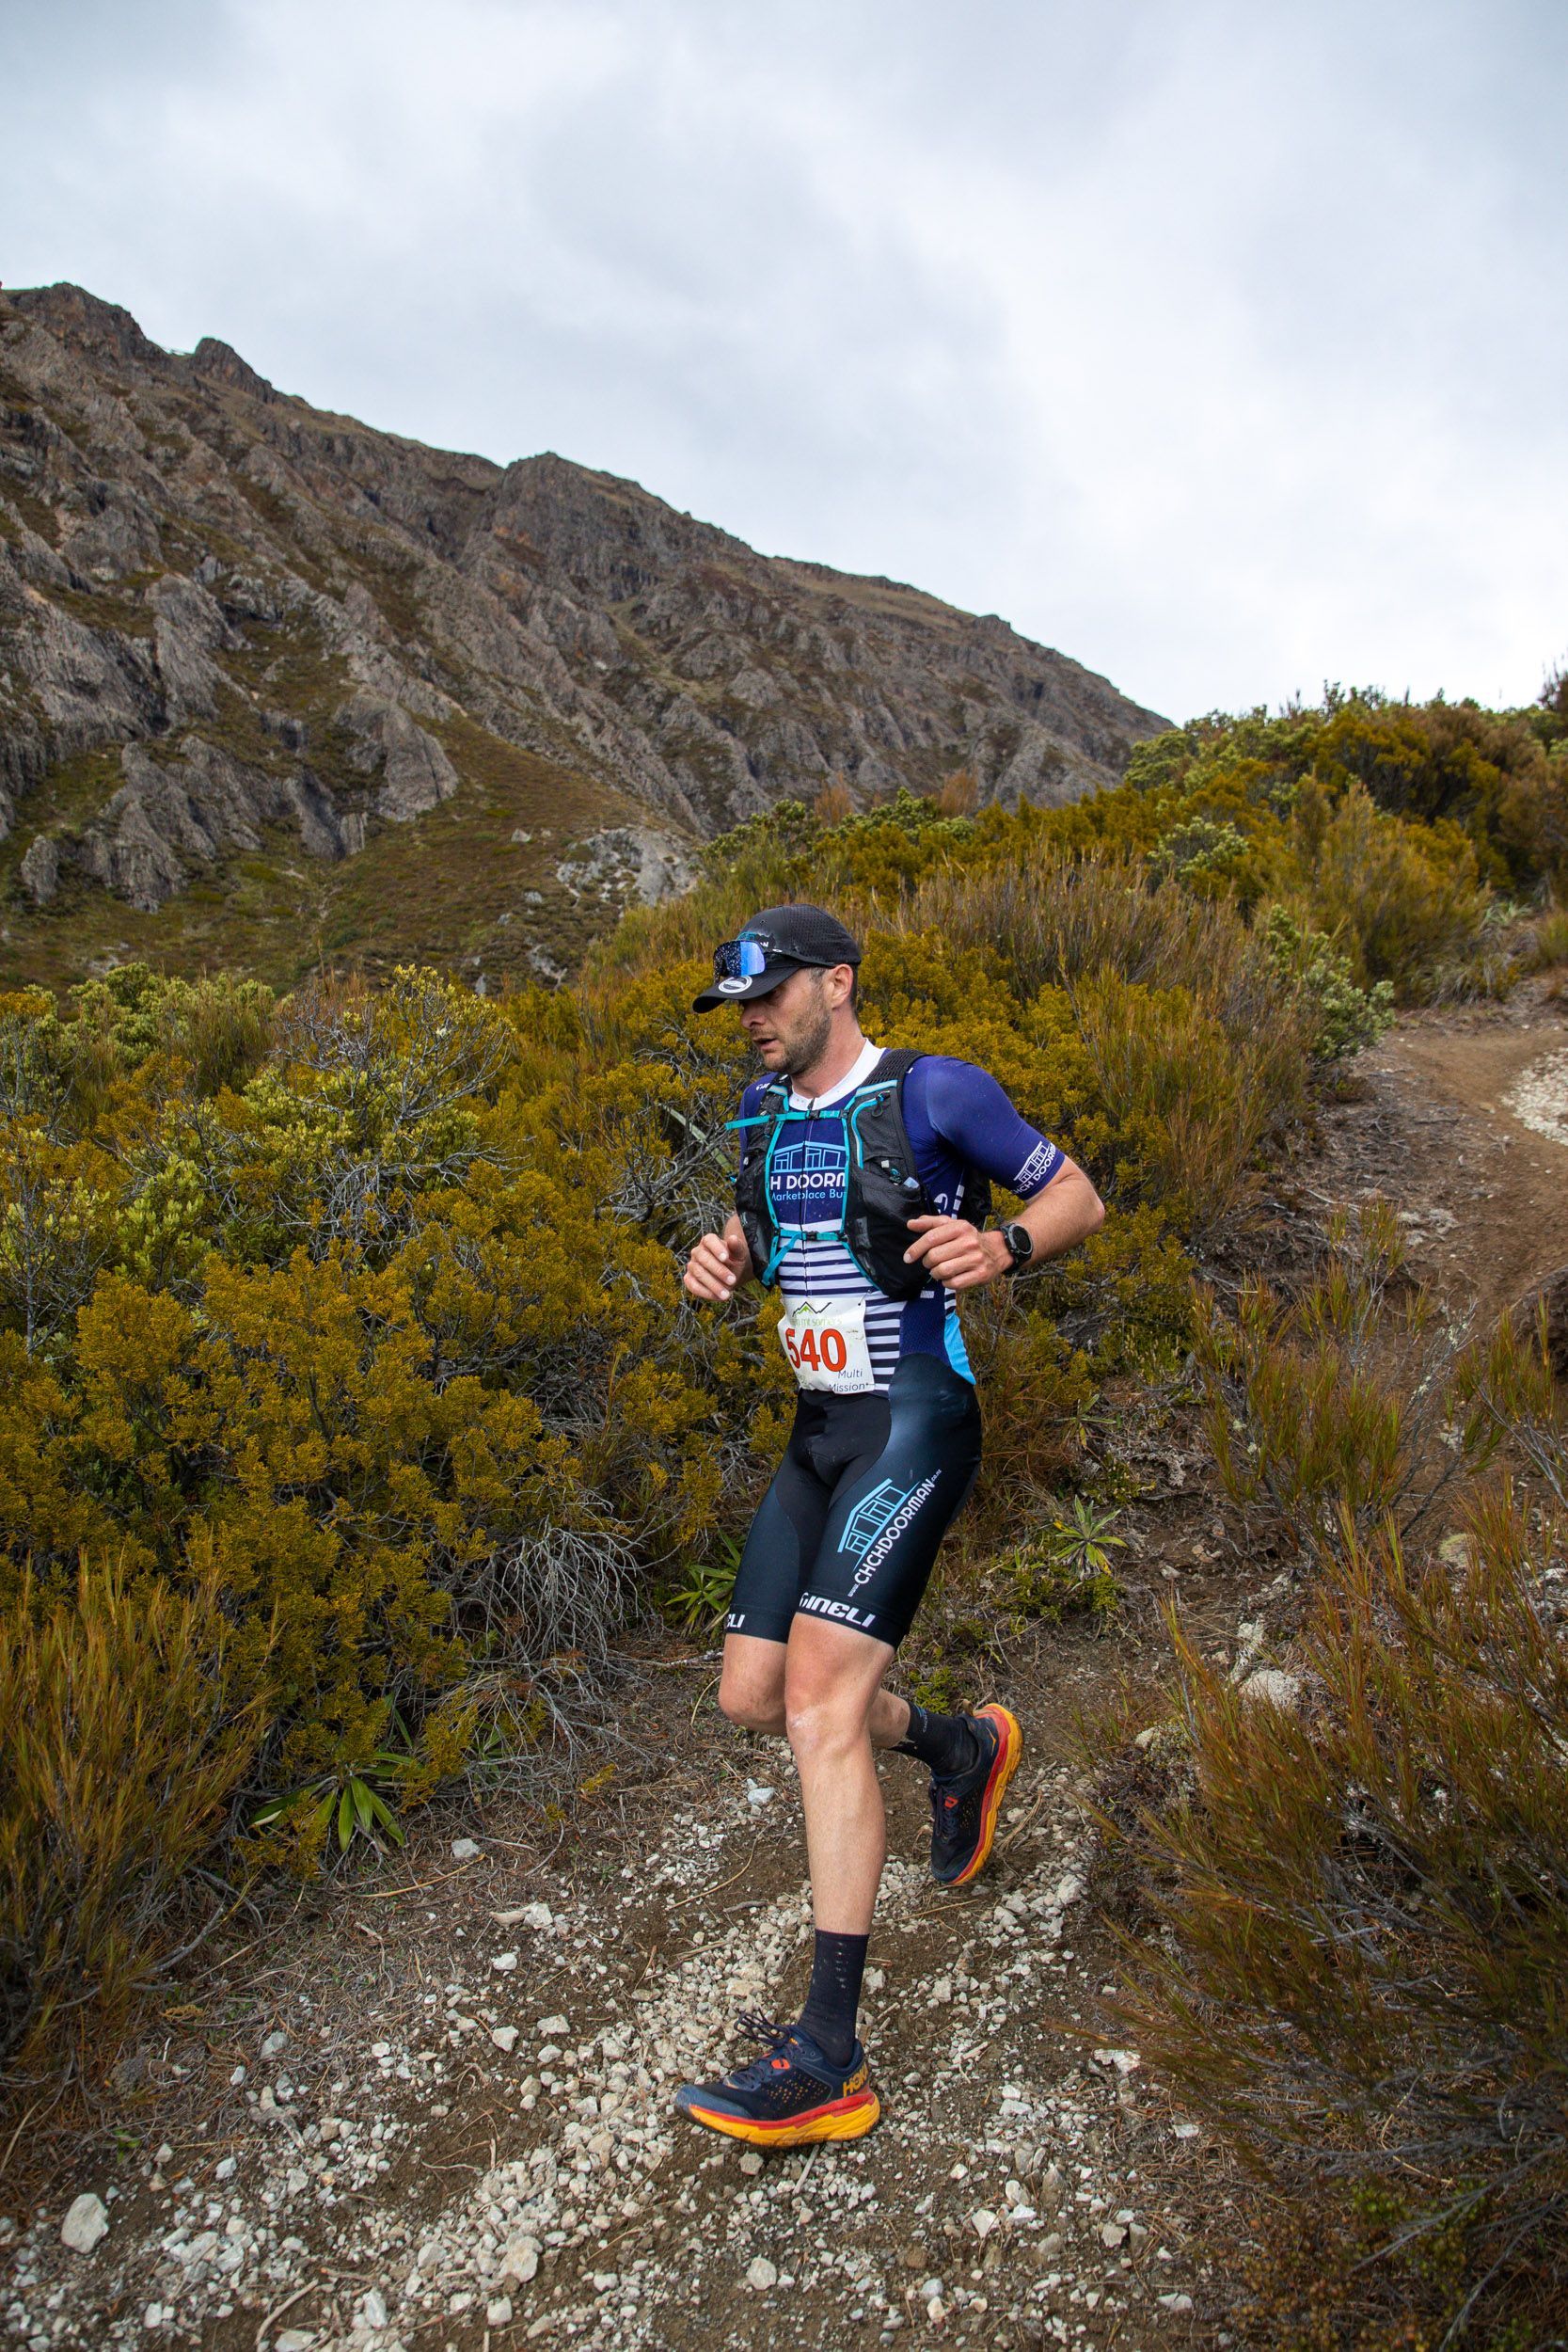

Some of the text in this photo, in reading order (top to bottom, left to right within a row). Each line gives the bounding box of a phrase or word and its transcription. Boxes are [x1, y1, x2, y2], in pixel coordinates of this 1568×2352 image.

[785, 1327, 847, 1372] 540
[838, 1369, 863, 1379] Multi
[829, 1383, 865, 1392] Mission
